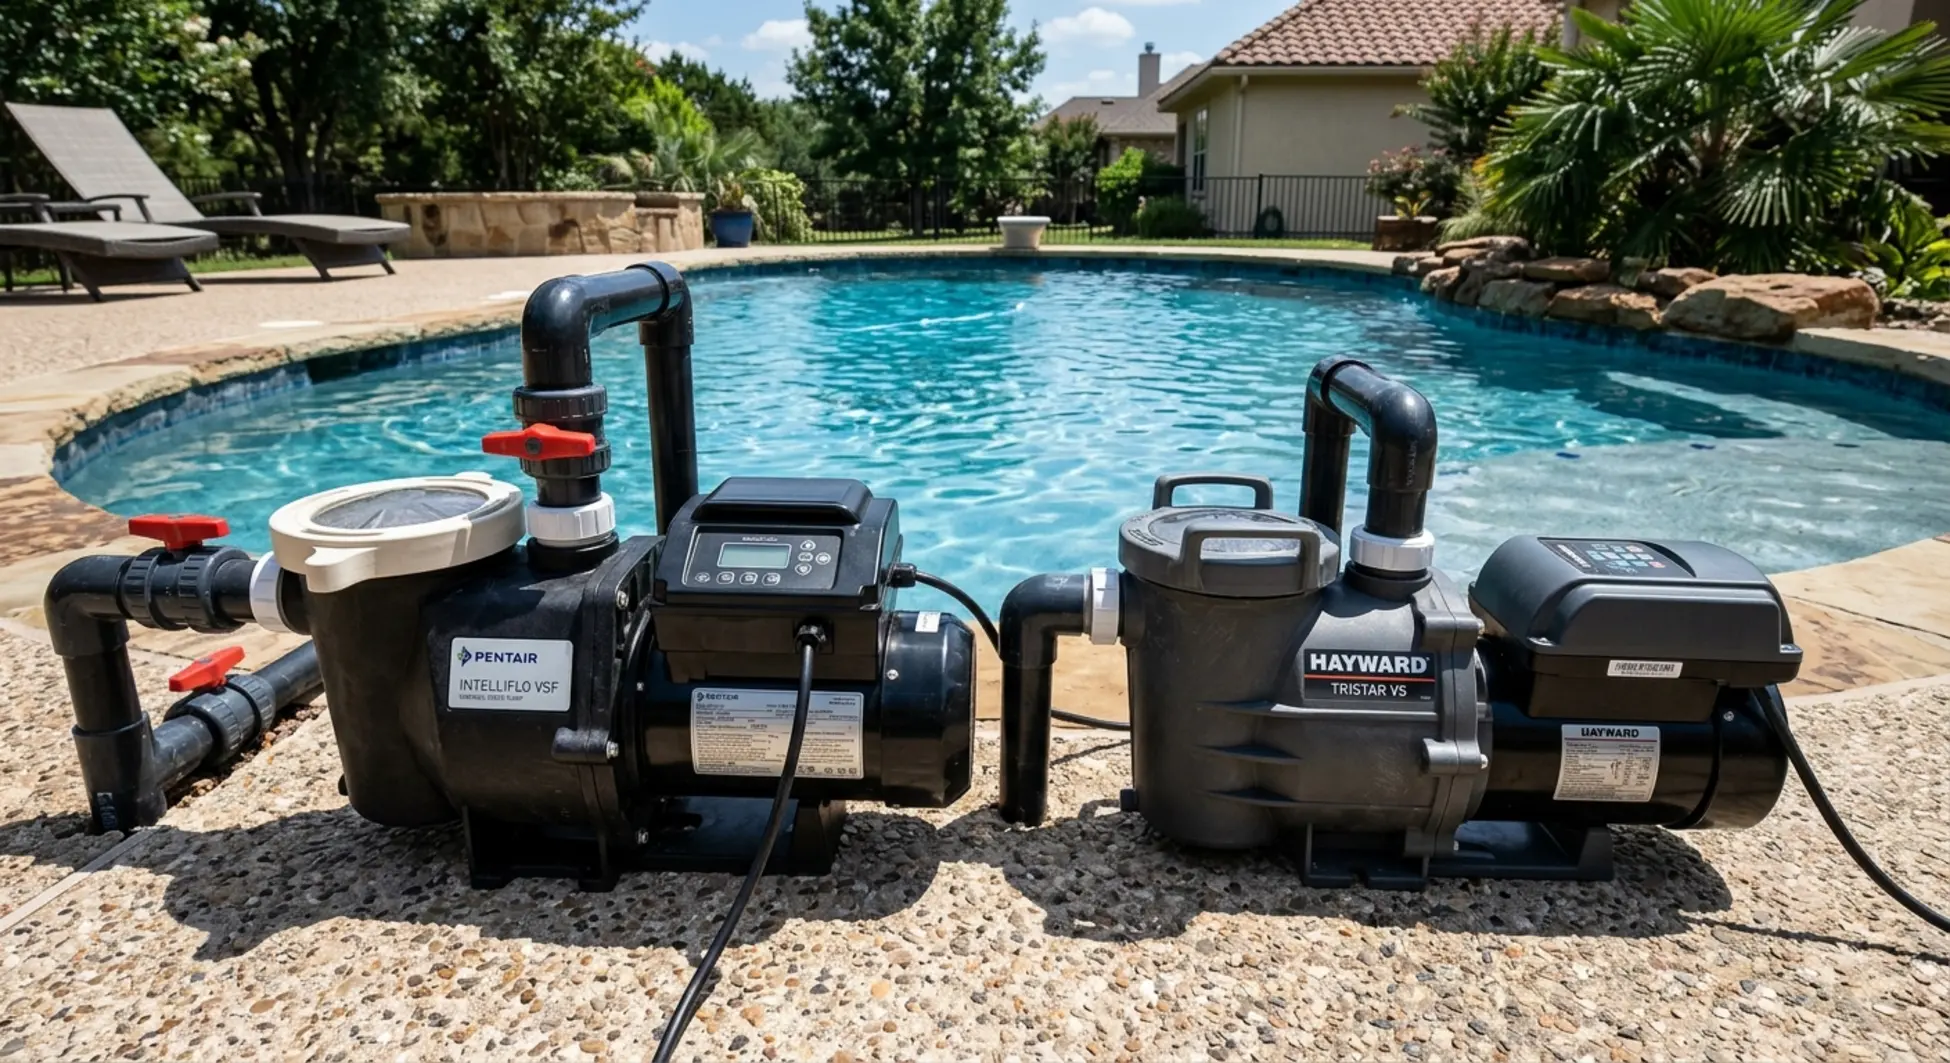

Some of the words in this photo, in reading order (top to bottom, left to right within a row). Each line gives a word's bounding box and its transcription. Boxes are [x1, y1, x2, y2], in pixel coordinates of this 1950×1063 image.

[474, 651, 538, 664] PENTAIR
[1310, 653, 1428, 674] HAYWARD
[459, 679, 531, 693] INTELLIFLO
[534, 681, 559, 694] VSF
[1331, 682, 1387, 697] TRISTAR
[1390, 684, 1407, 697] VS
